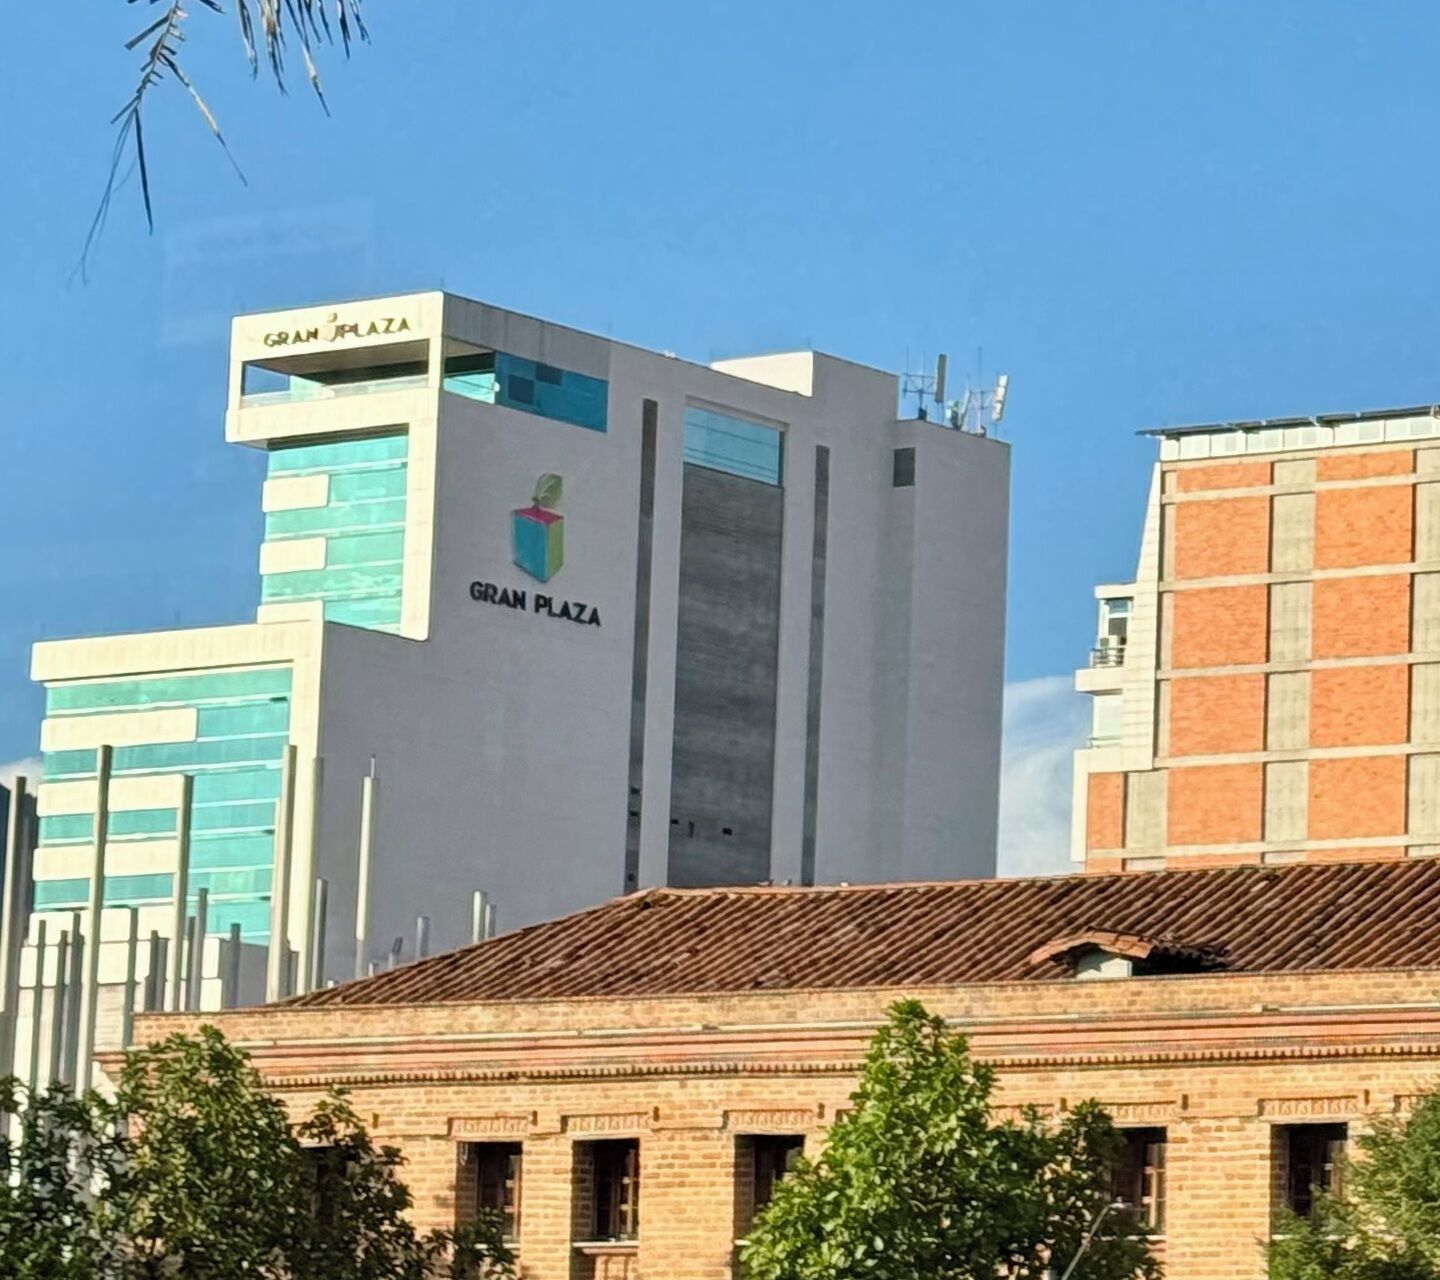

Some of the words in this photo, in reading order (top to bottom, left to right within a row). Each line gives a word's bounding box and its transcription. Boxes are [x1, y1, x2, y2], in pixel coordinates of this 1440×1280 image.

[263, 327, 319, 347] GRAN
[334, 317, 411, 341] PLAZA
[469, 581, 527, 612] GRAN
[534, 593, 602, 628] PLAZA
